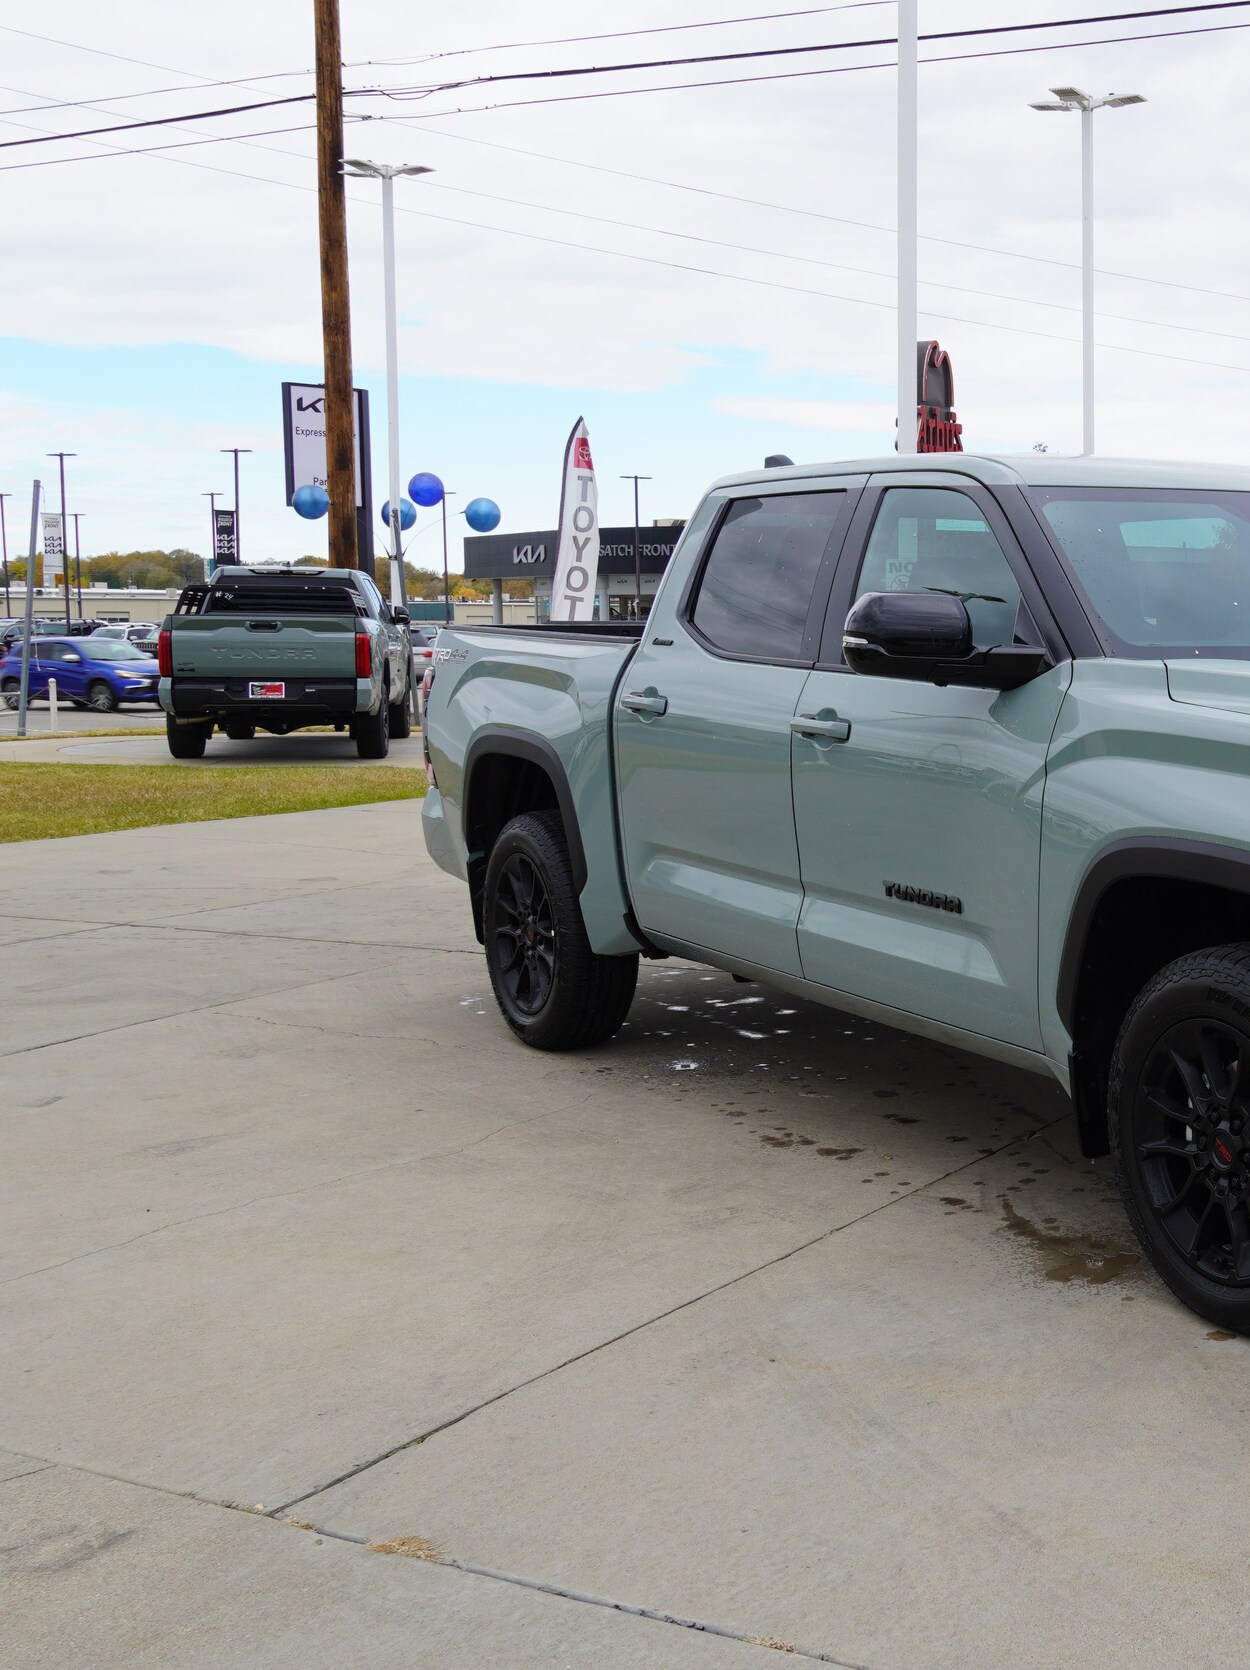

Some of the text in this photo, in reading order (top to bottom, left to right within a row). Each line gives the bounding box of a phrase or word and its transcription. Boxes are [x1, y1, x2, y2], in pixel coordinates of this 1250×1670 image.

[295, 426, 327, 437] Express
[313, 477, 328, 486] Par
[513, 544, 547, 564] KIA
[599, 544, 634, 556] SATCH
[563, 475, 595, 621] TOYOT
[210, 646, 317, 660] TUNDRA
[434, 648, 452, 662] TRD
[882, 880, 963, 914] TUNDRA
[1215, 1137, 1233, 1164] TRD
